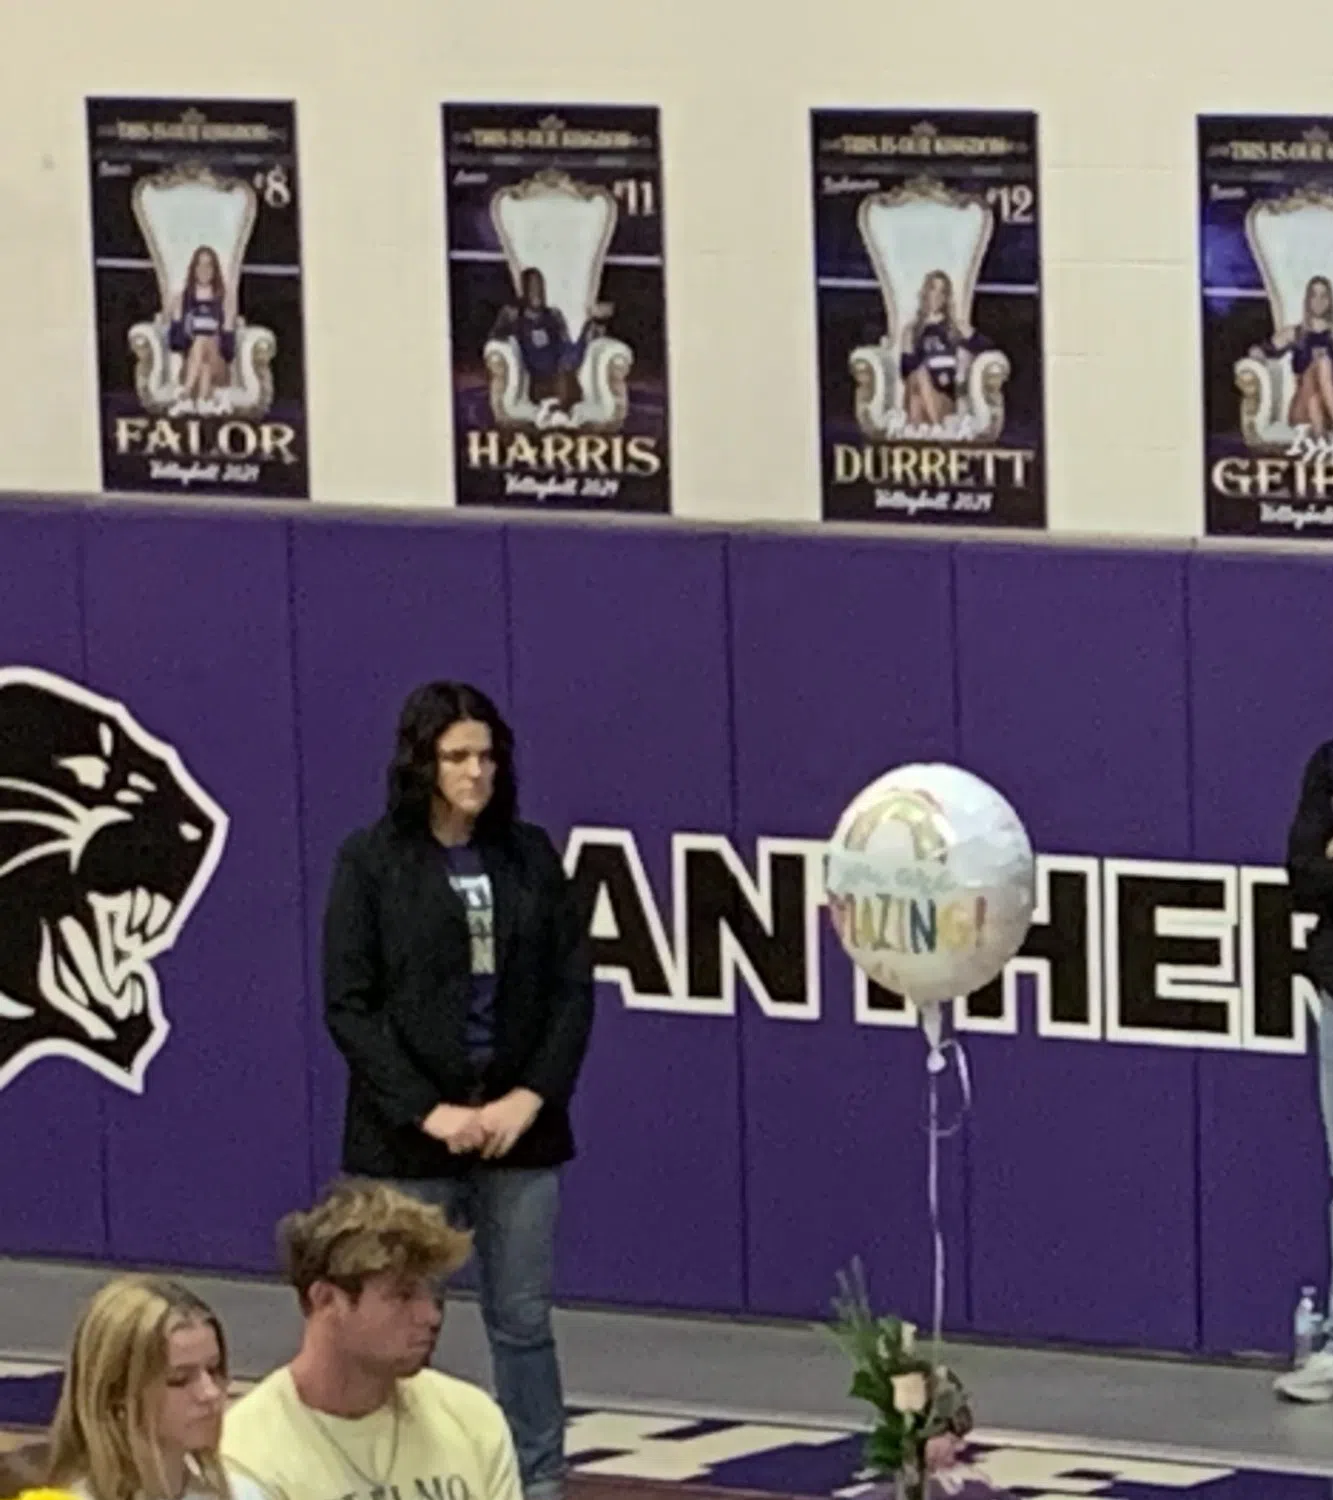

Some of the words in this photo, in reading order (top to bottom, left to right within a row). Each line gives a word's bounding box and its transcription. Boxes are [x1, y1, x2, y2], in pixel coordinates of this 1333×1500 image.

[115, 418, 298, 464] FALOR
[467, 431, 661, 477] HARRIS
[832, 443, 1035, 488] DURRETT
